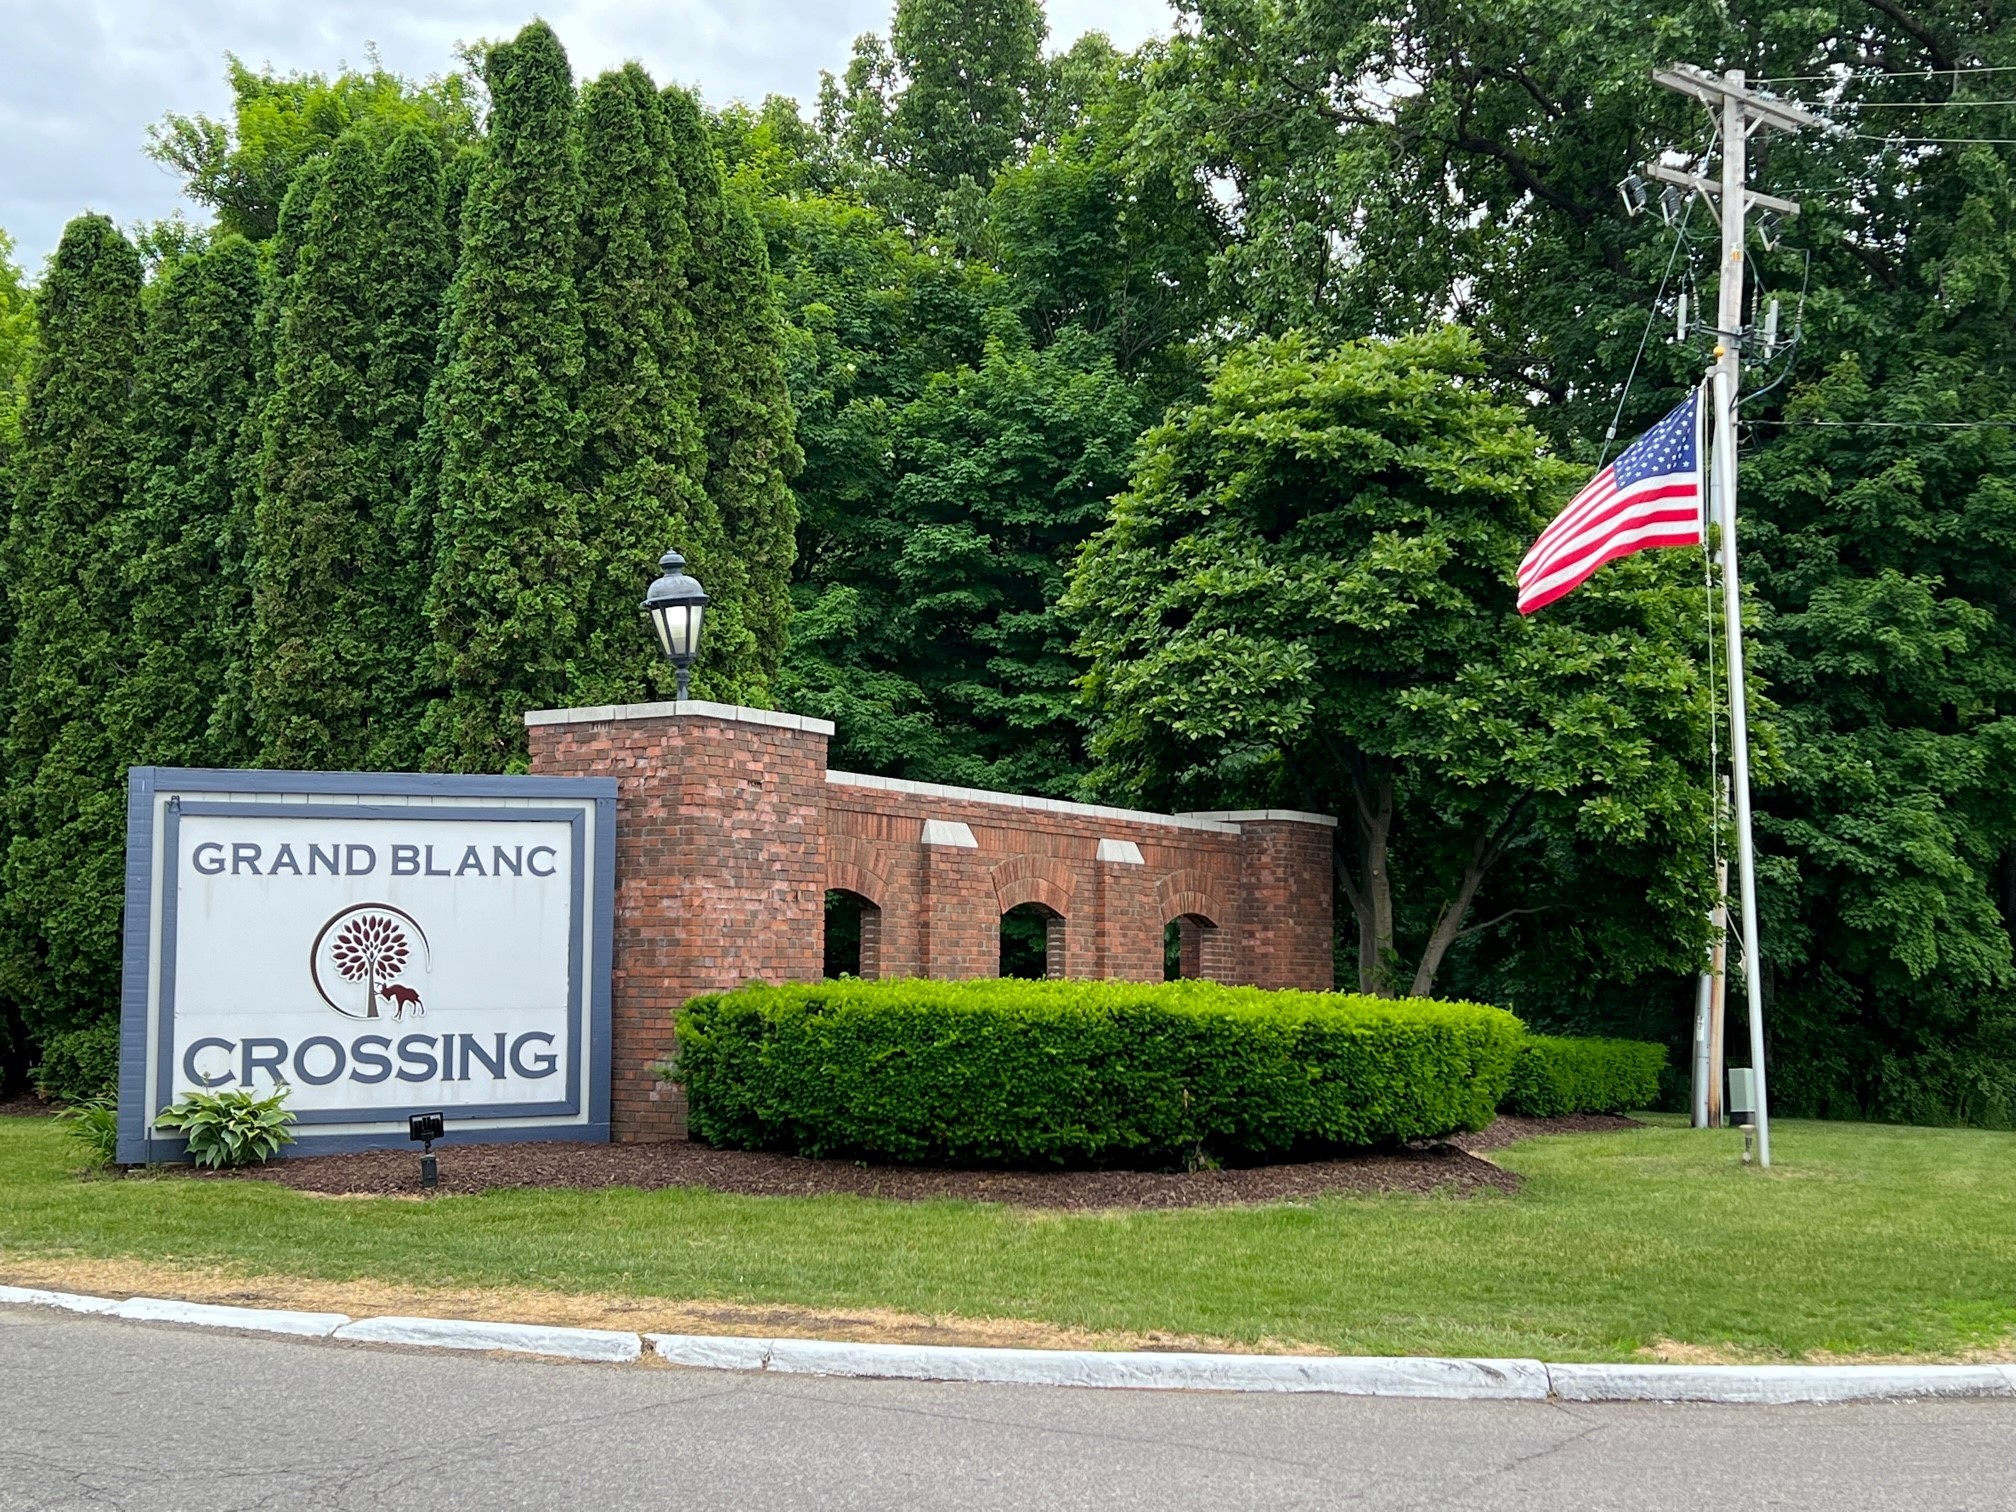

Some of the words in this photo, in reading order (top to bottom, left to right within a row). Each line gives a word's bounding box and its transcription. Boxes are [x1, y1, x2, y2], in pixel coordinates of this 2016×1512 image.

[192, 842, 376, 875] GRAND
[391, 844, 557, 877] BLANC
[183, 1031, 558, 1087] CROSSING
